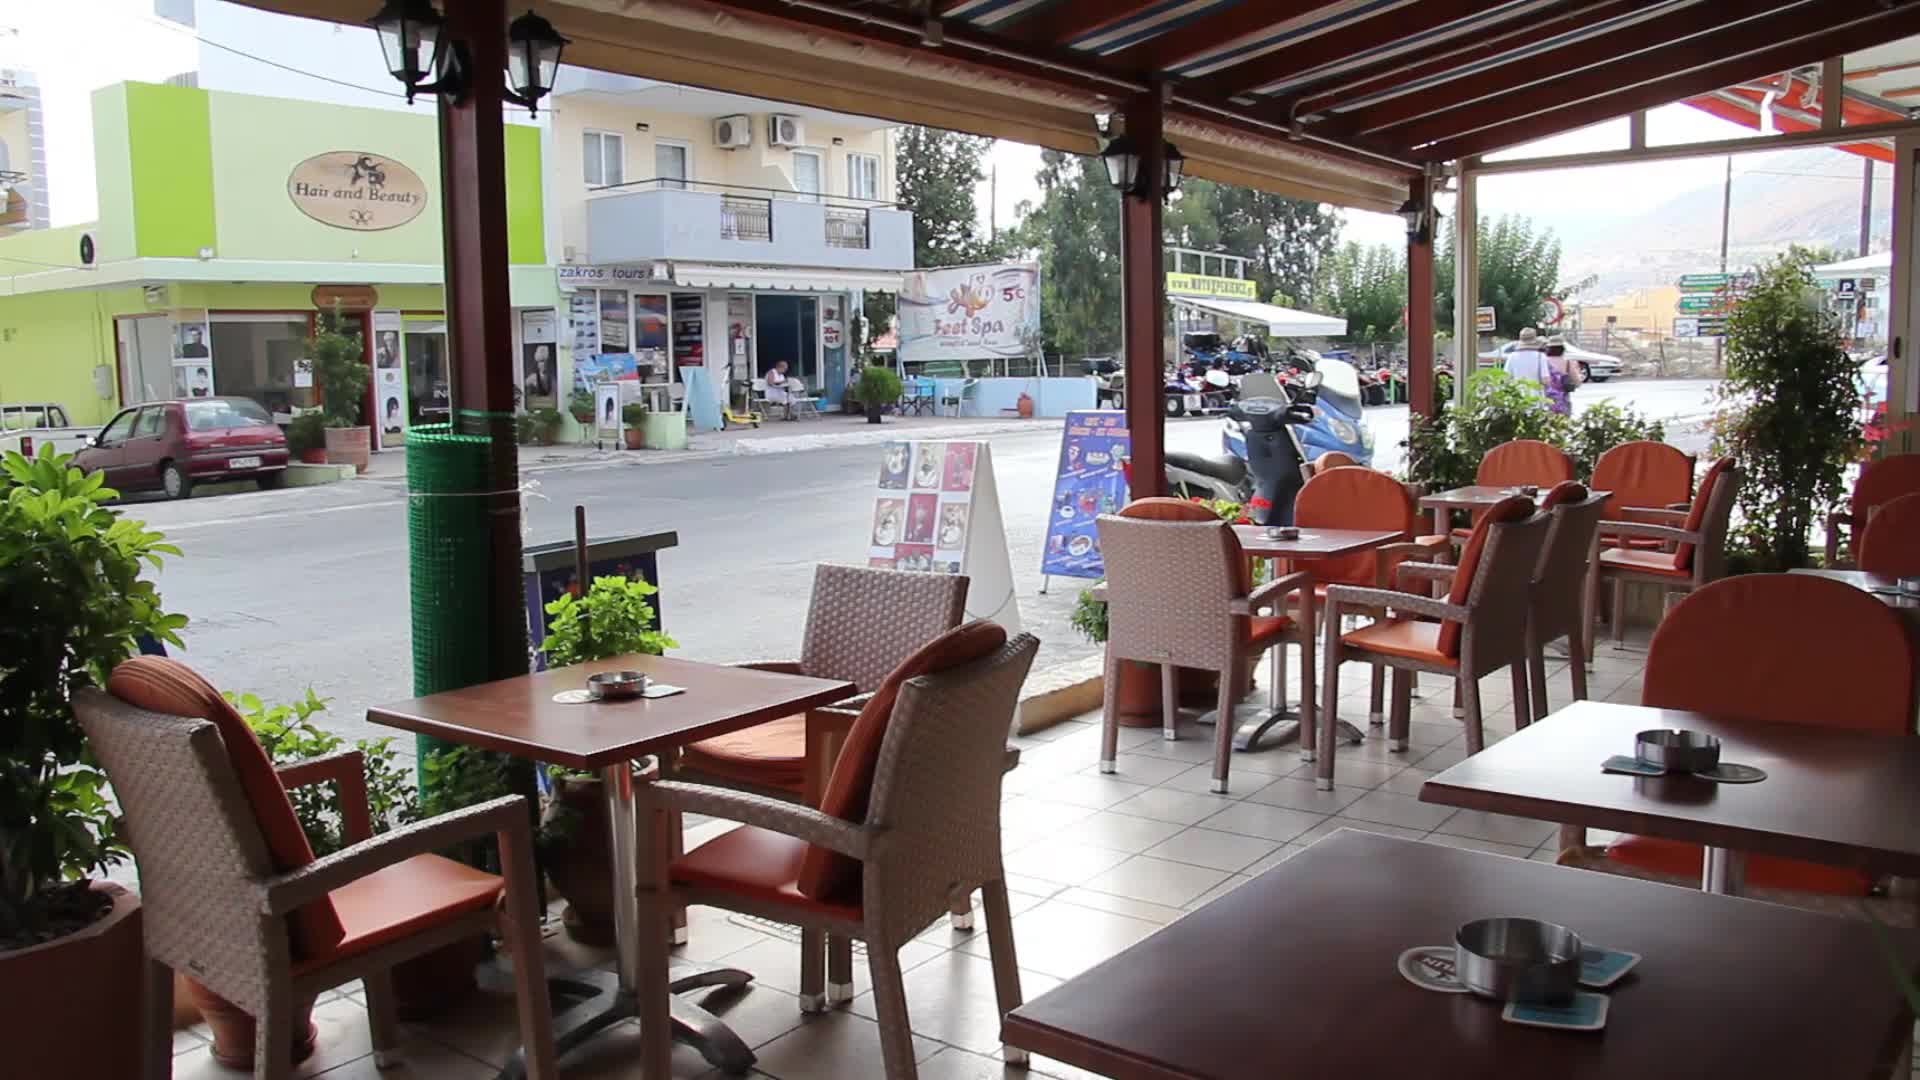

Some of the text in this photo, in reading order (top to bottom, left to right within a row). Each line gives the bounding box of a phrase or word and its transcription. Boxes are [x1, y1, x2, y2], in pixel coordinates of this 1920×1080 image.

[295, 182, 420, 205] Hair and Beauty
[559, 266, 604, 279] zakros
[613, 267, 646, 279] tours
[1842, 282, 1852, 291] P
[971, 316, 1005, 337] Spa
